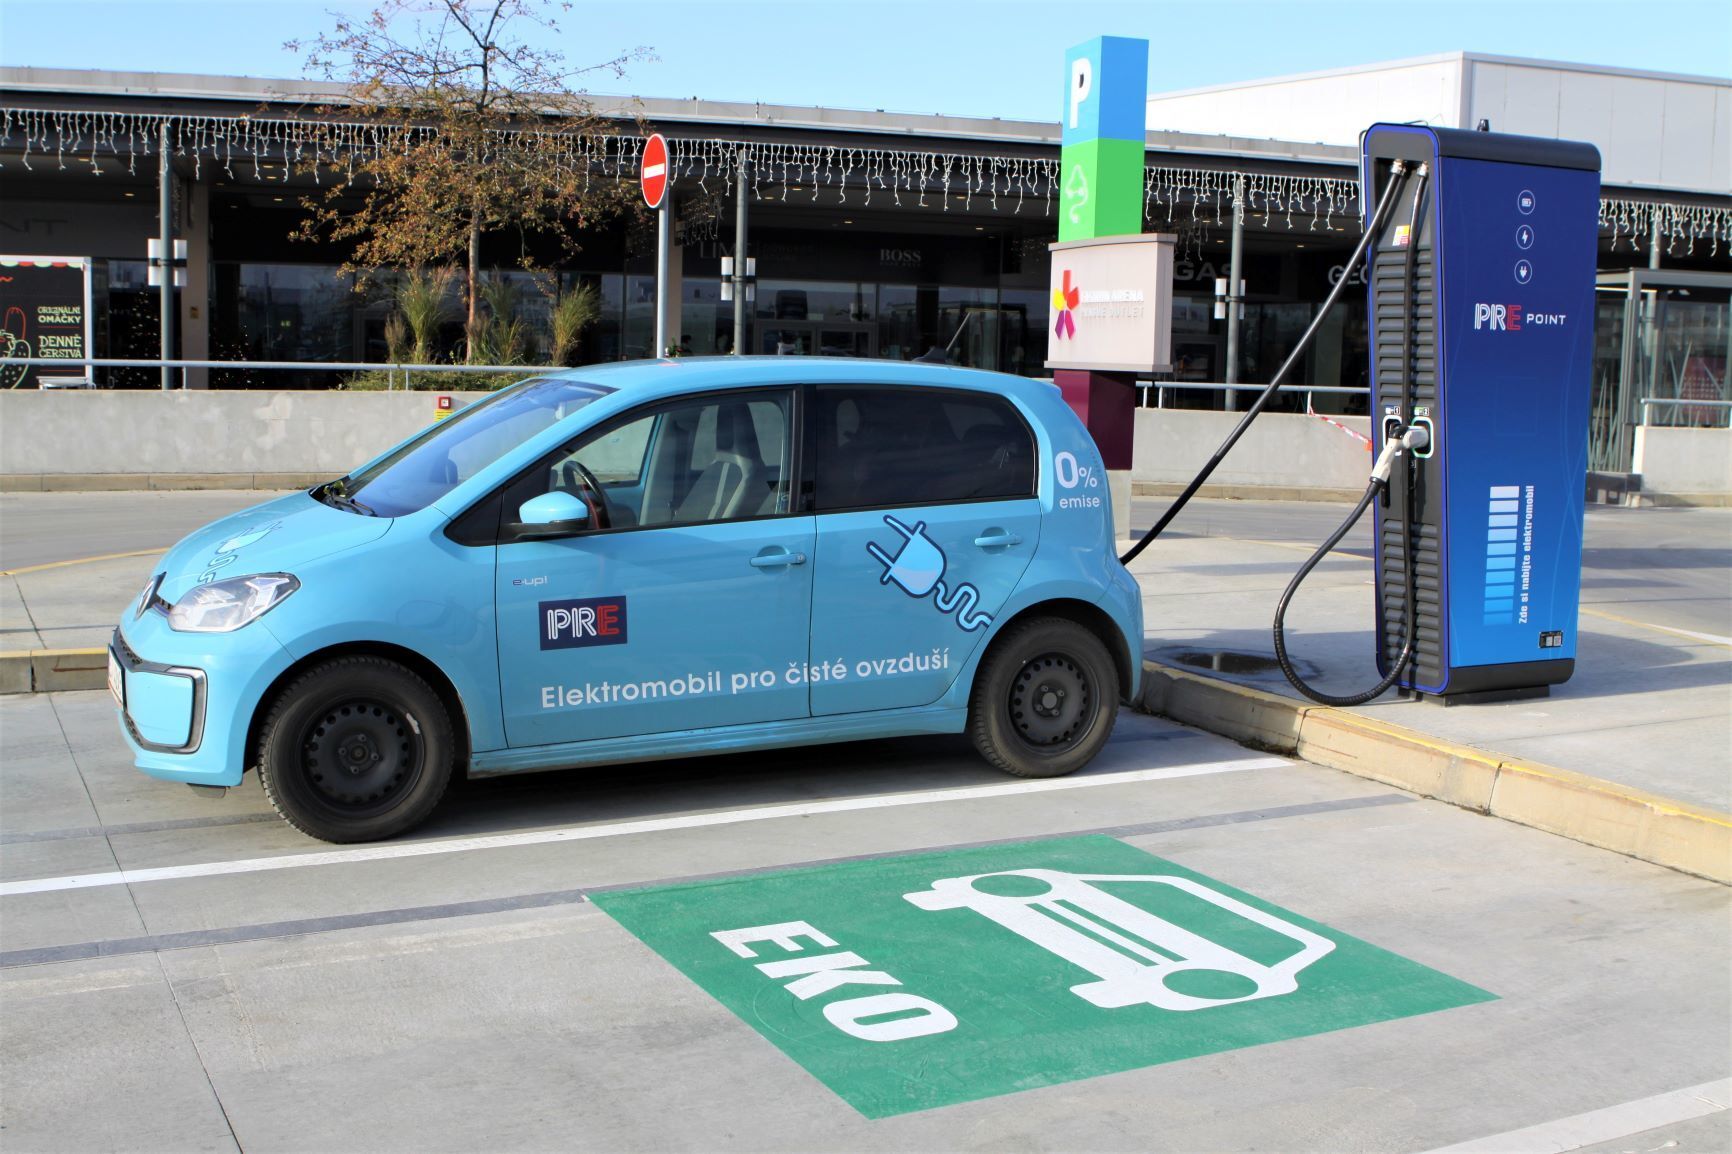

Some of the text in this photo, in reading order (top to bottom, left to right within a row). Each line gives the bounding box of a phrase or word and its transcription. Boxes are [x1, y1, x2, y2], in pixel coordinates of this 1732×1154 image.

[1069, 58, 1092, 129] P
[880, 248, 921, 262] BOSS
[38, 313, 81, 323] OMÁČKY
[1474, 303, 1566, 331] PRE POINT
[38, 333, 82, 348] DENNĚ
[1054, 451, 1098, 489] 0%
[1059, 494, 1100, 509] emise
[1518, 485, 1535, 624] Zde si nabijte elektromobil
[512, 576, 548, 586] e-up!
[547, 605, 620, 640] PRE
[541, 647, 949, 708] Elektromobil pro čisté ovzduší
[709, 920, 958, 1042] EKO
